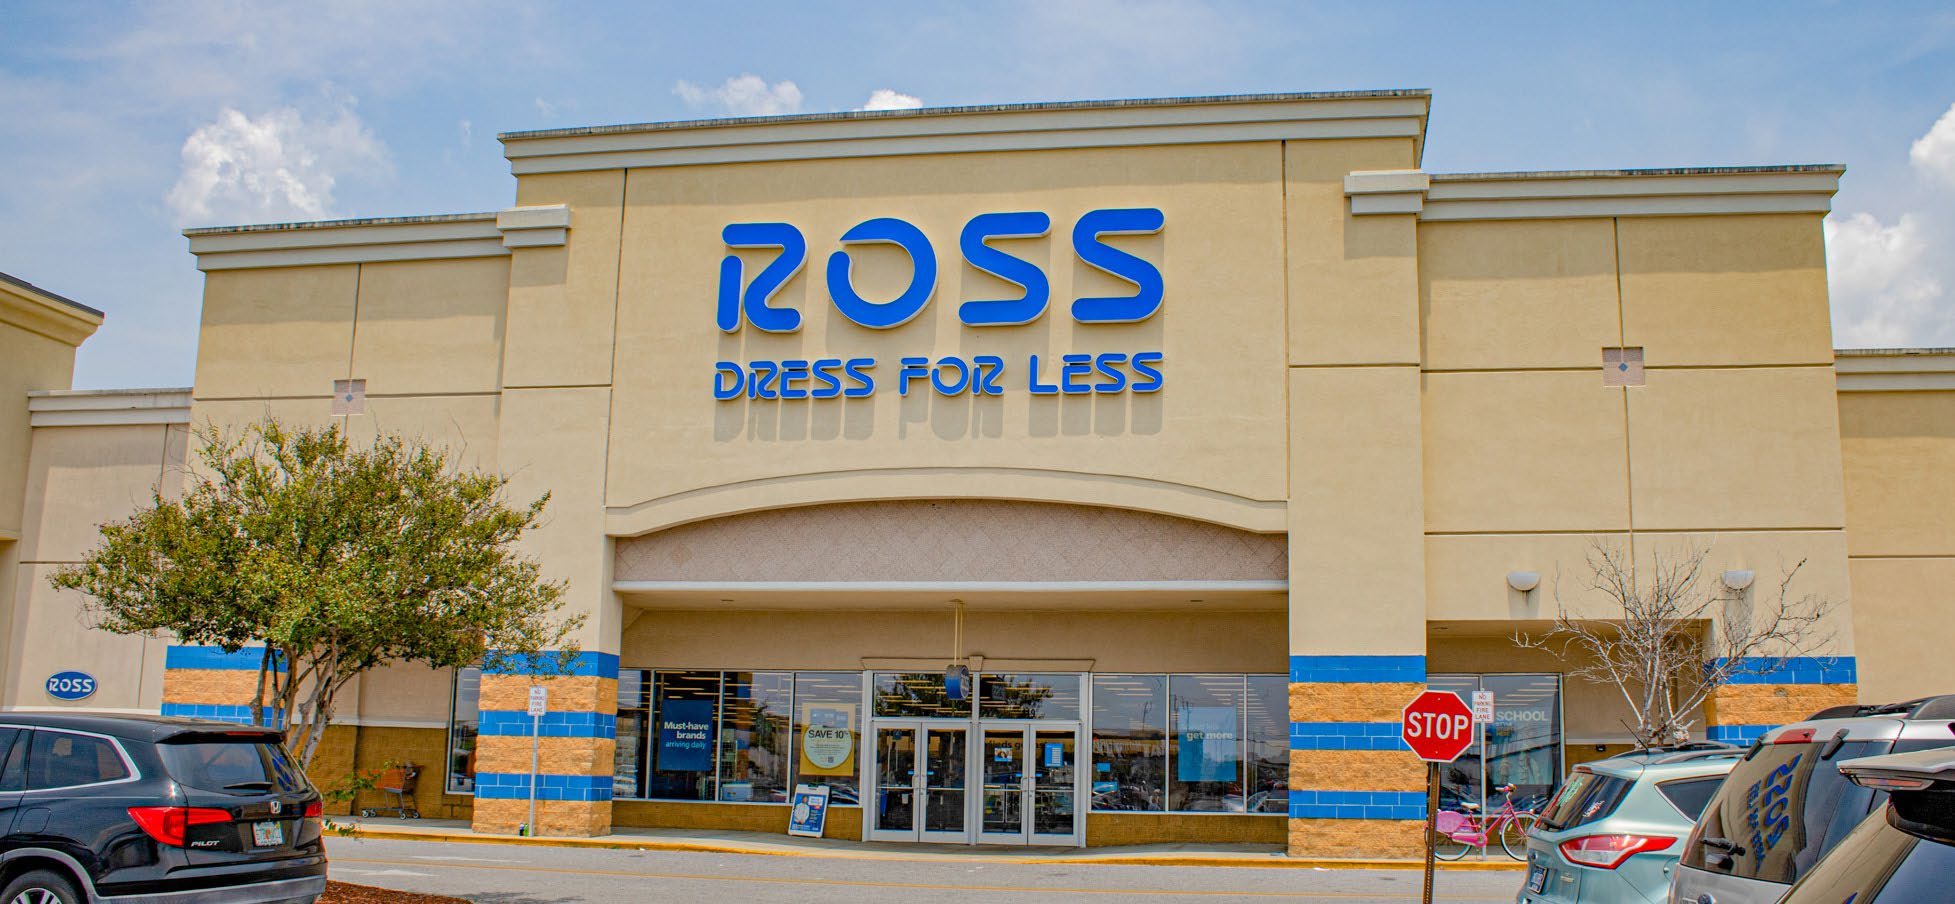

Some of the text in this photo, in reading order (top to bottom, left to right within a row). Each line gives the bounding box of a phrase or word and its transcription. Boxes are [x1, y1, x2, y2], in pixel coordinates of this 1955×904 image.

[716, 208, 1165, 334] ROSS
[714, 352, 1164, 400] DRESS FOR LESS
[49, 678, 93, 692] ROSS
[1496, 711, 1549, 722] SCHOOL
[664, 721, 709, 730] Must-have
[1407, 711, 1469, 740] STOP
[676, 731, 706, 740] brands
[808, 730, 833, 738] SAVE
[1186, 731, 1204, 742] get
[665, 741, 706, 750] arriving daily
